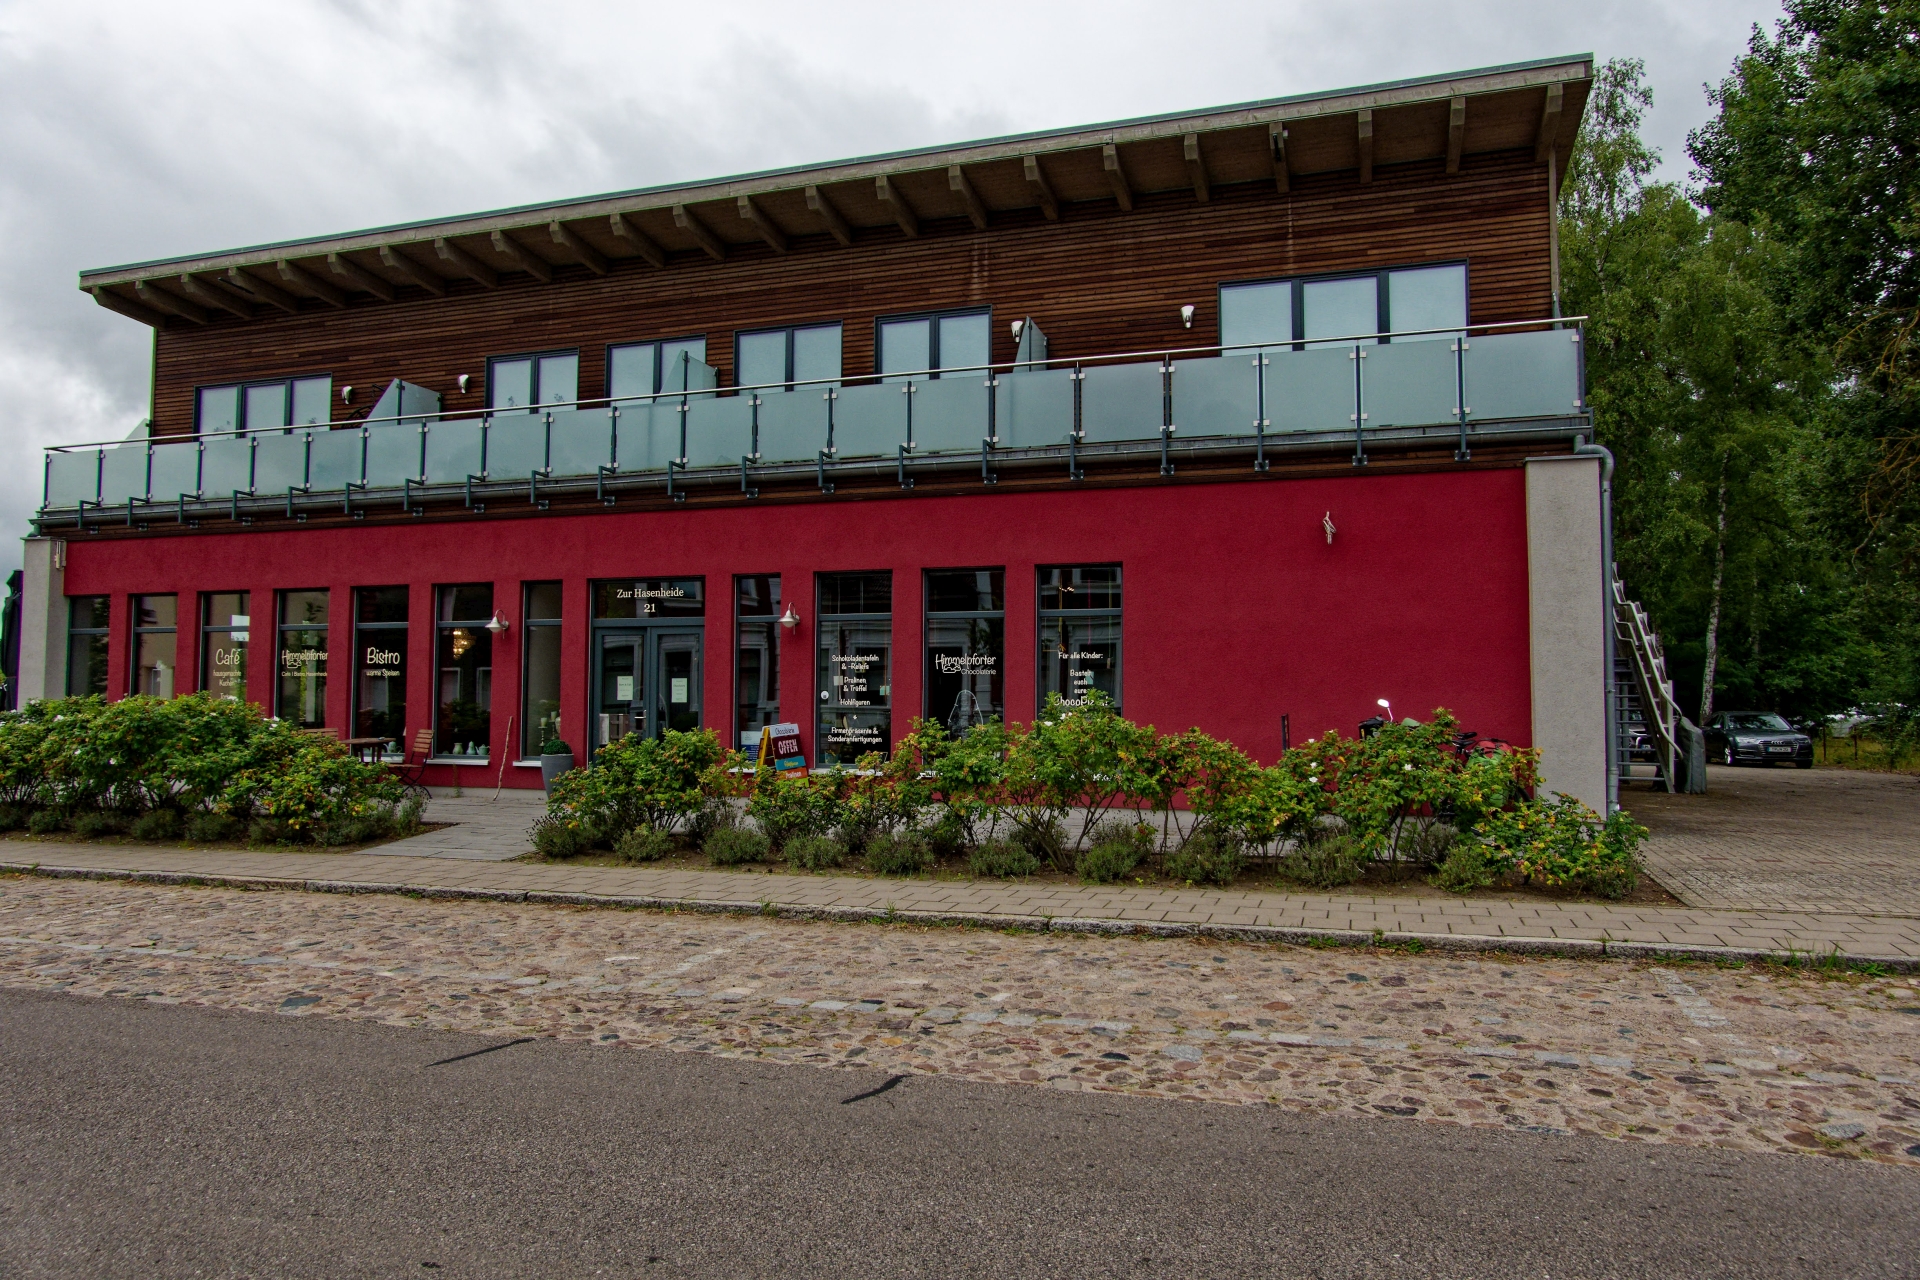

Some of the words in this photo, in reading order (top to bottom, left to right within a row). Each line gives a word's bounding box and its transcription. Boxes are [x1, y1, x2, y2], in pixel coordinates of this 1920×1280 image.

[616, 588, 633, 598] Zur
[634, 587, 684, 598] Hasenheide
[643, 603, 656, 613] 21
[215, 648, 240, 665] Café
[366, 646, 400, 664] Bistro
[831, 654, 880, 662] Schokoladentafeln
[1080, 651, 1104, 659] Kinder:
[841, 662, 847, 670] &
[935, 652, 997, 670] Himmelpforter
[778, 738, 799, 755] OFFEN
